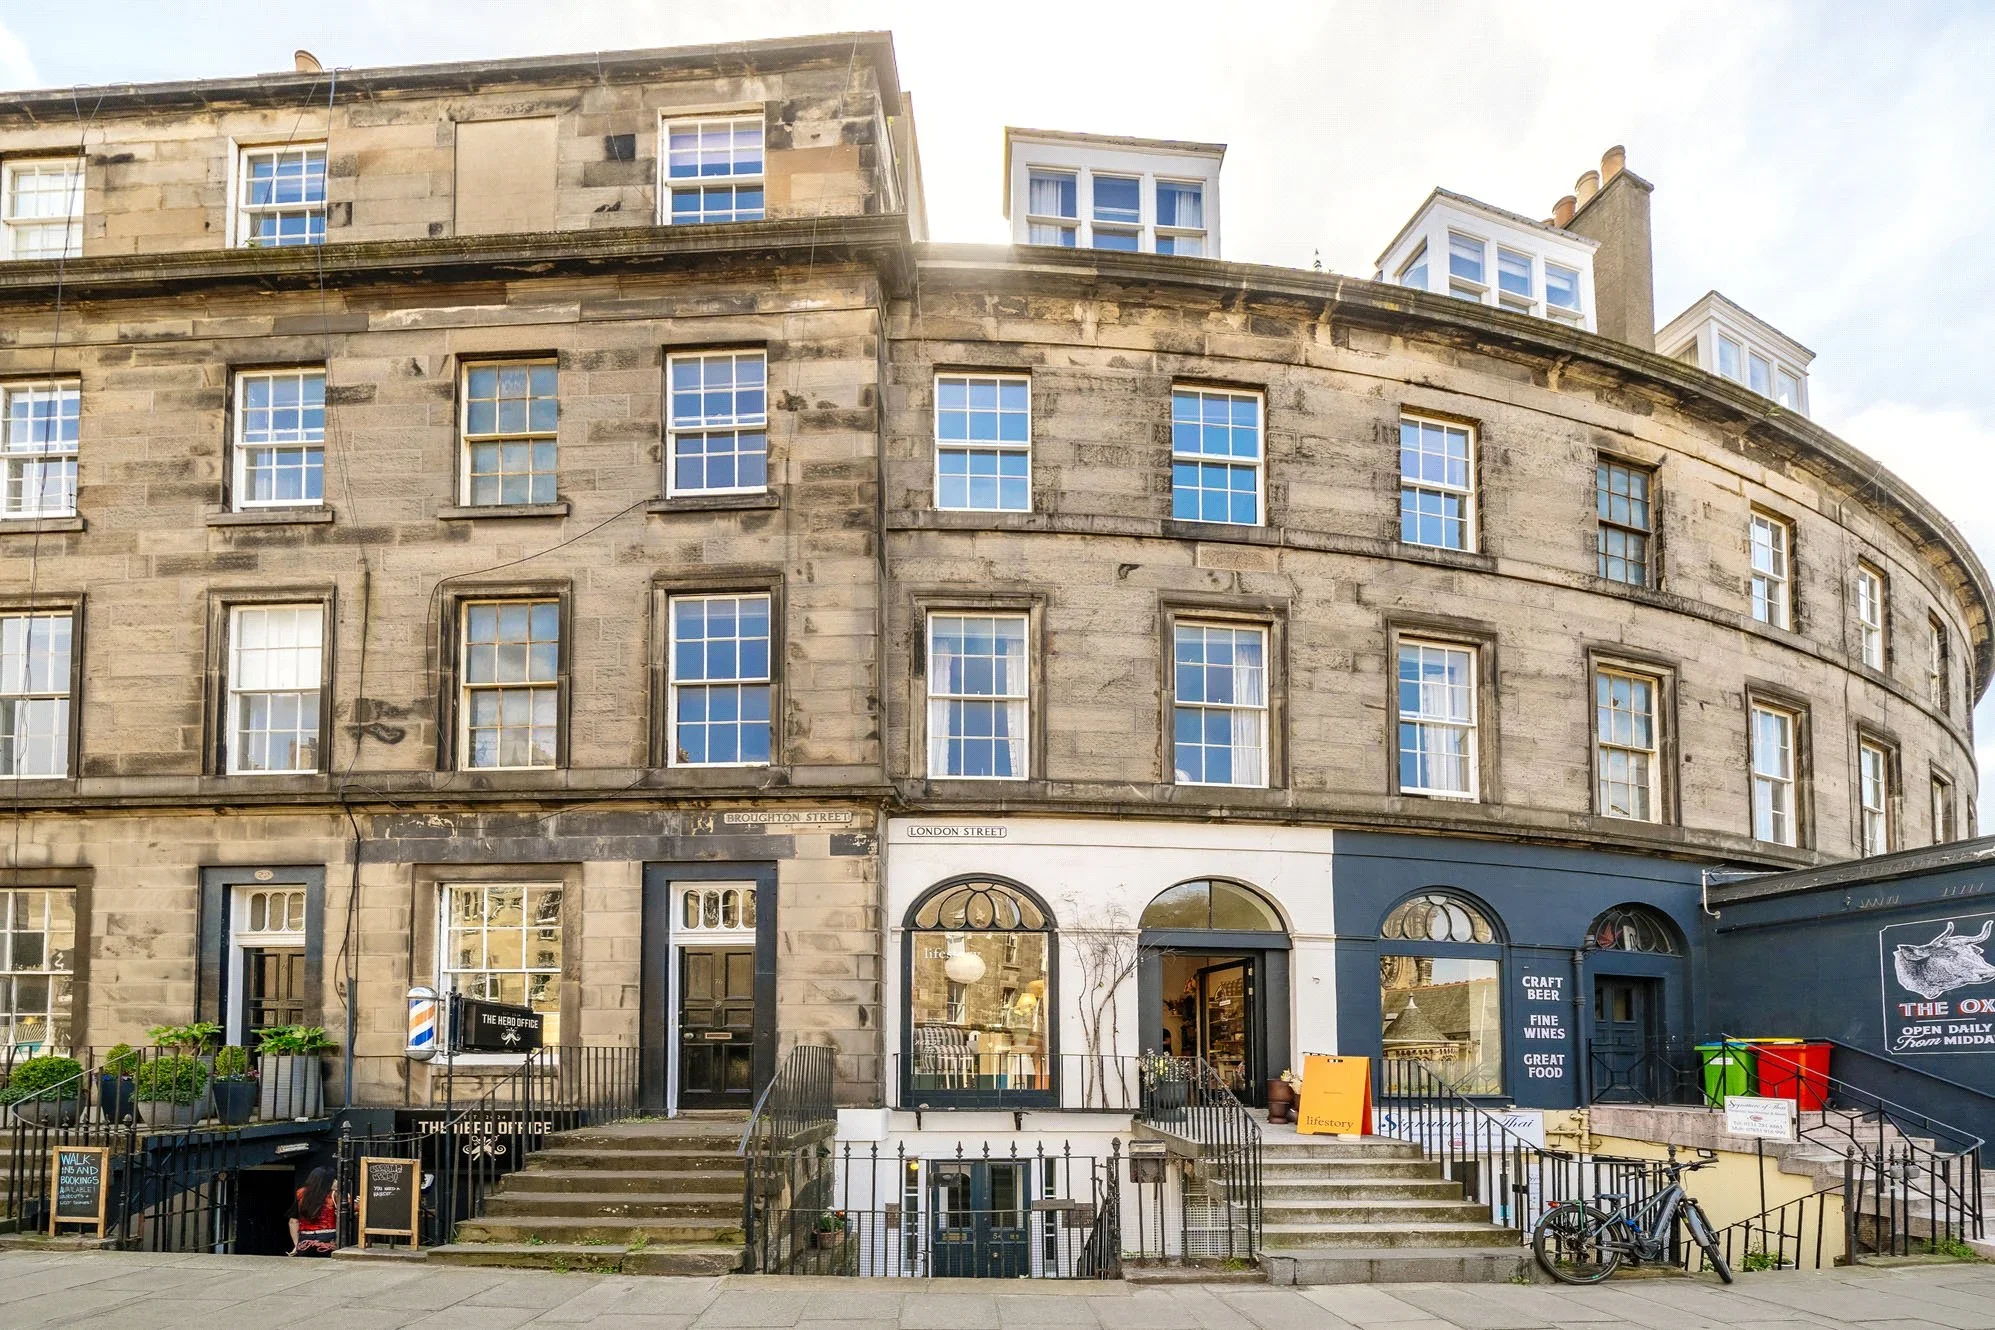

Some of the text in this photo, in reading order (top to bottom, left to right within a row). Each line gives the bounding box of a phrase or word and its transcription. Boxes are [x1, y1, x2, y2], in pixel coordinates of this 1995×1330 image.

[726, 812, 849, 822] BROUGHTON STREET
[910, 827, 1003, 836] LONDON STREET
[1522, 975, 1563, 988] CRAFT
[1527, 989, 1560, 1001] BEER
[1898, 998, 1995, 1017] THE OX
[482, 1013, 497, 1025] THE
[498, 1016, 516, 1027] HEAD
[517, 1019, 539, 1029] OFFICE
[1530, 1014, 1559, 1026] FINE
[1523, 1027, 1566, 1040] WINES
[1902, 1023, 1993, 1035] OPEN DAILY
[1893, 1034, 1995, 1051] From MIDDA
[1523, 1053, 1565, 1066] GREAT
[1528, 1067, 1563, 1079] FOOD
[418, 1121, 446, 1134] THE
[1306, 1115, 1354, 1131] lifestory
[1499, 1114, 1535, 1128] Thai
[61, 1152, 96, 1165] WALK-
[76, 1166, 99, 1175] AND
[60, 1175, 100, 1185] BOOKINGS
